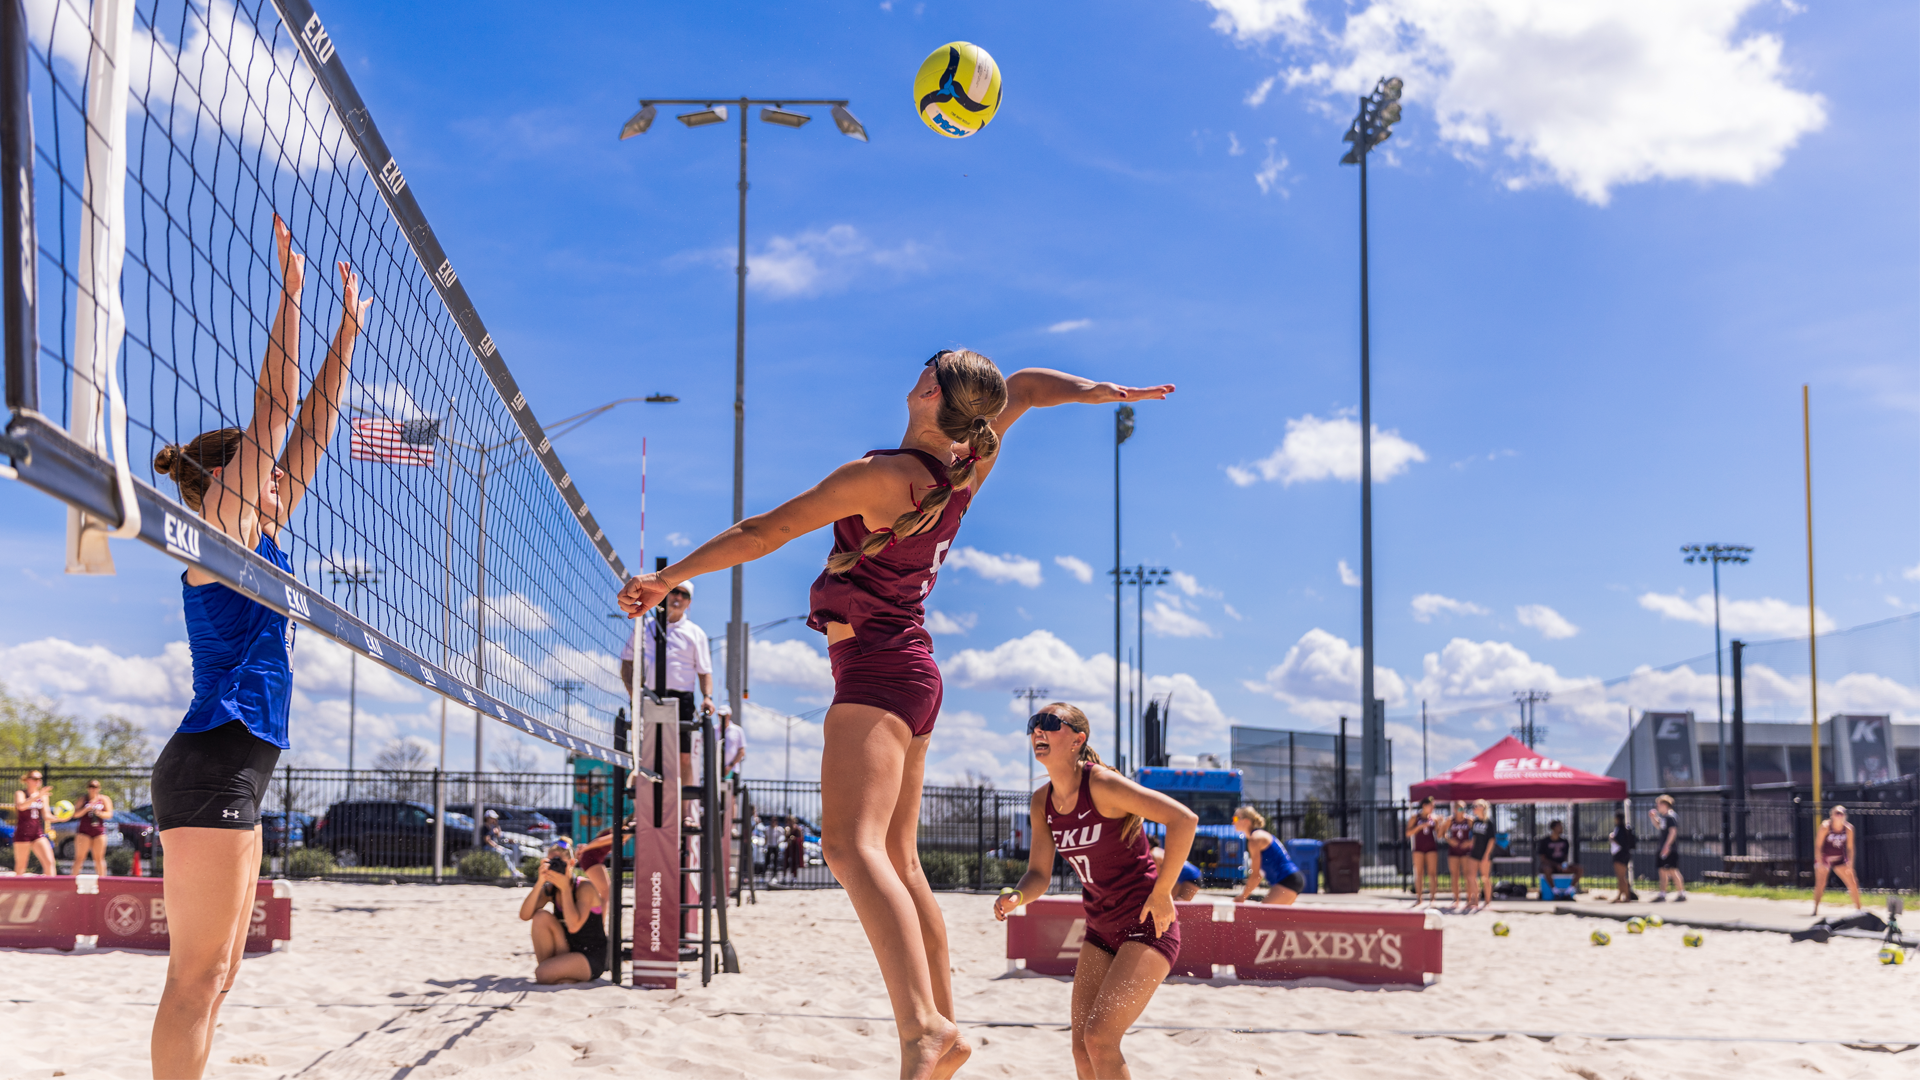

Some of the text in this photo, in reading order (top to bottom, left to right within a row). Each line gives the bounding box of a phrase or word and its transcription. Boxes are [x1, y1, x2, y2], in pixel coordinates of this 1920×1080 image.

[304, 11, 335, 65] EKU
[932, 113, 971, 136] NCAA
[382, 156, 407, 195] EKU
[438, 258, 458, 288] EKU
[480, 332, 497, 357] EKU
[164, 512, 200, 558] EKU
[285, 584, 311, 617] EKU
[363, 631, 384, 656] EKU
[1656, 717, 1686, 740] E
[1850, 719, 1881, 743] K
[1052, 823, 1102, 848] EKU
[1069, 855, 1094, 884] 17
[649, 871, 662, 953] sports imports
[1254, 928, 1402, 969] ZAXBY'S
